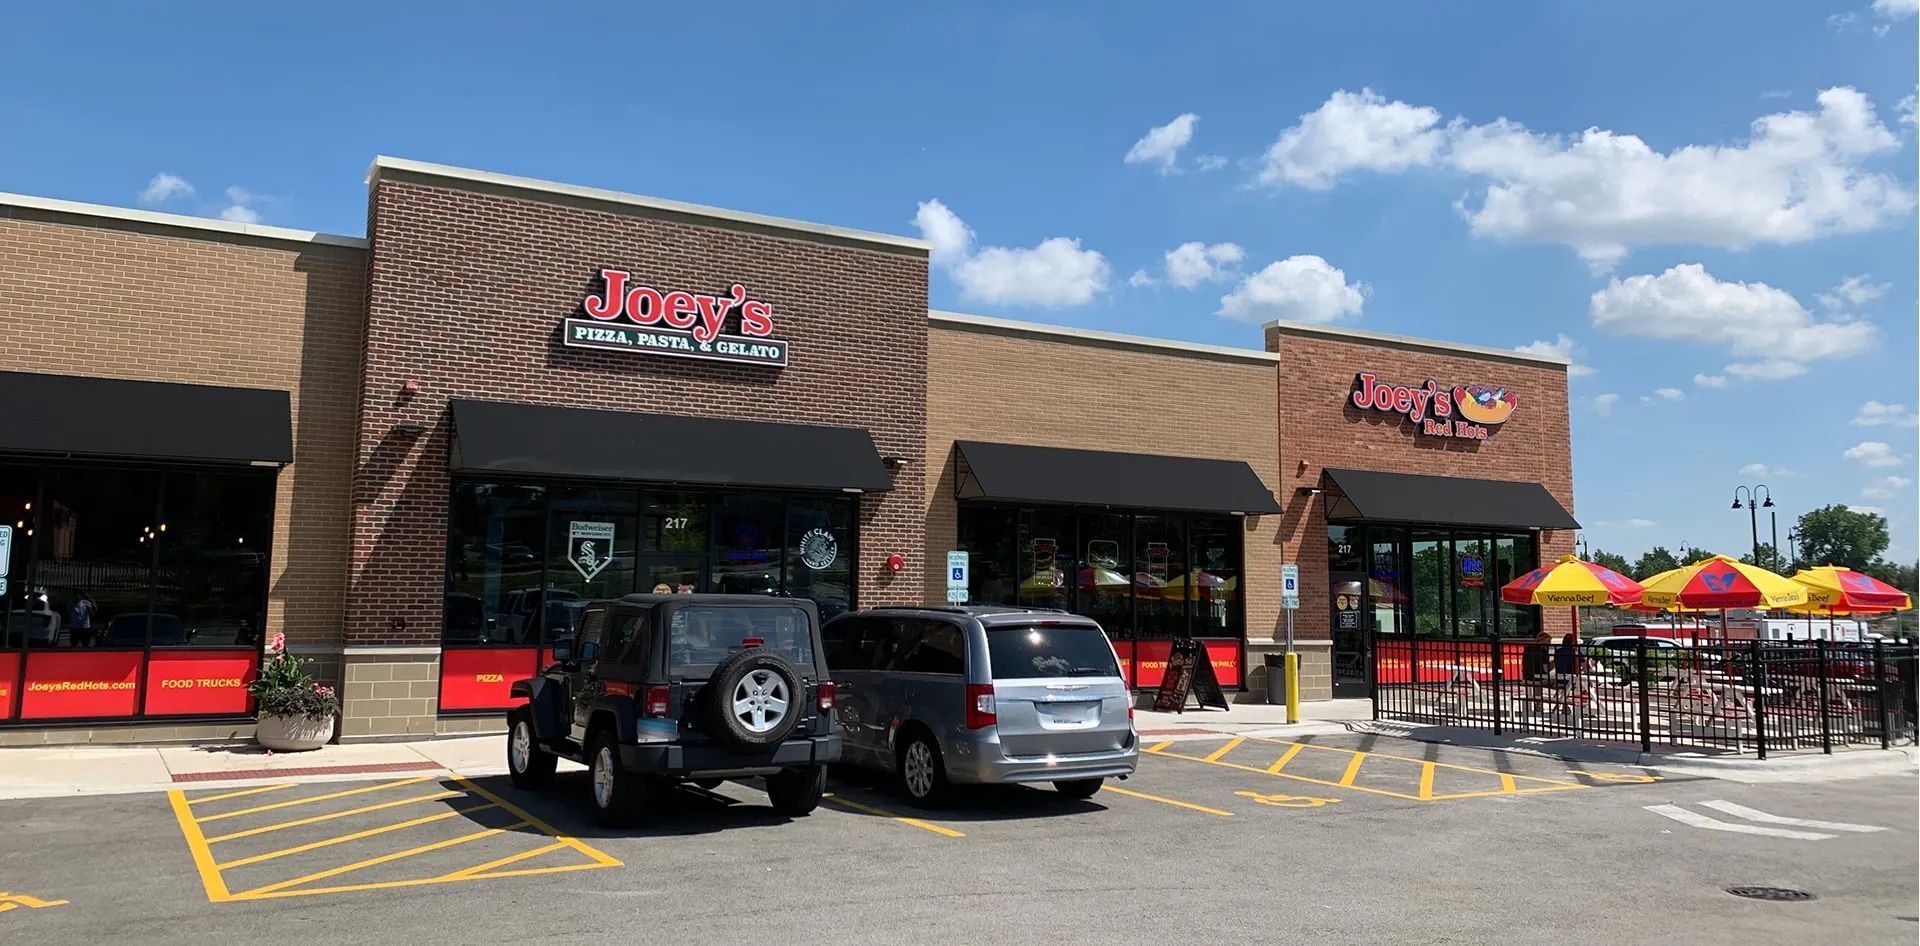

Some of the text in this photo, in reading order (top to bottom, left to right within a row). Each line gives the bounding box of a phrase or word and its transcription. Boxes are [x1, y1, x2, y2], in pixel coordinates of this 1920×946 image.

[585, 269, 773, 343] Joey's
[575, 326, 780, 358] PIZZA, PASTA, & GELATO
[1353, 372, 1451, 422] Joey's
[1424, 418, 1488, 439] Red Hots
[572, 522, 613, 532] Budweiser
[665, 517, 688, 529] 217
[800, 528, 835, 555] WHITE CLAW
[1338, 544, 1351, 553] 217
[1547, 594, 1595, 603] Vienna Beef
[1141, 661, 1158, 669] FOOD
[162, 678, 241, 688] FOOD TRUCKS
[476, 674, 504, 682] PIZZA
[28, 681, 136, 692] JoeysRedHots.com
